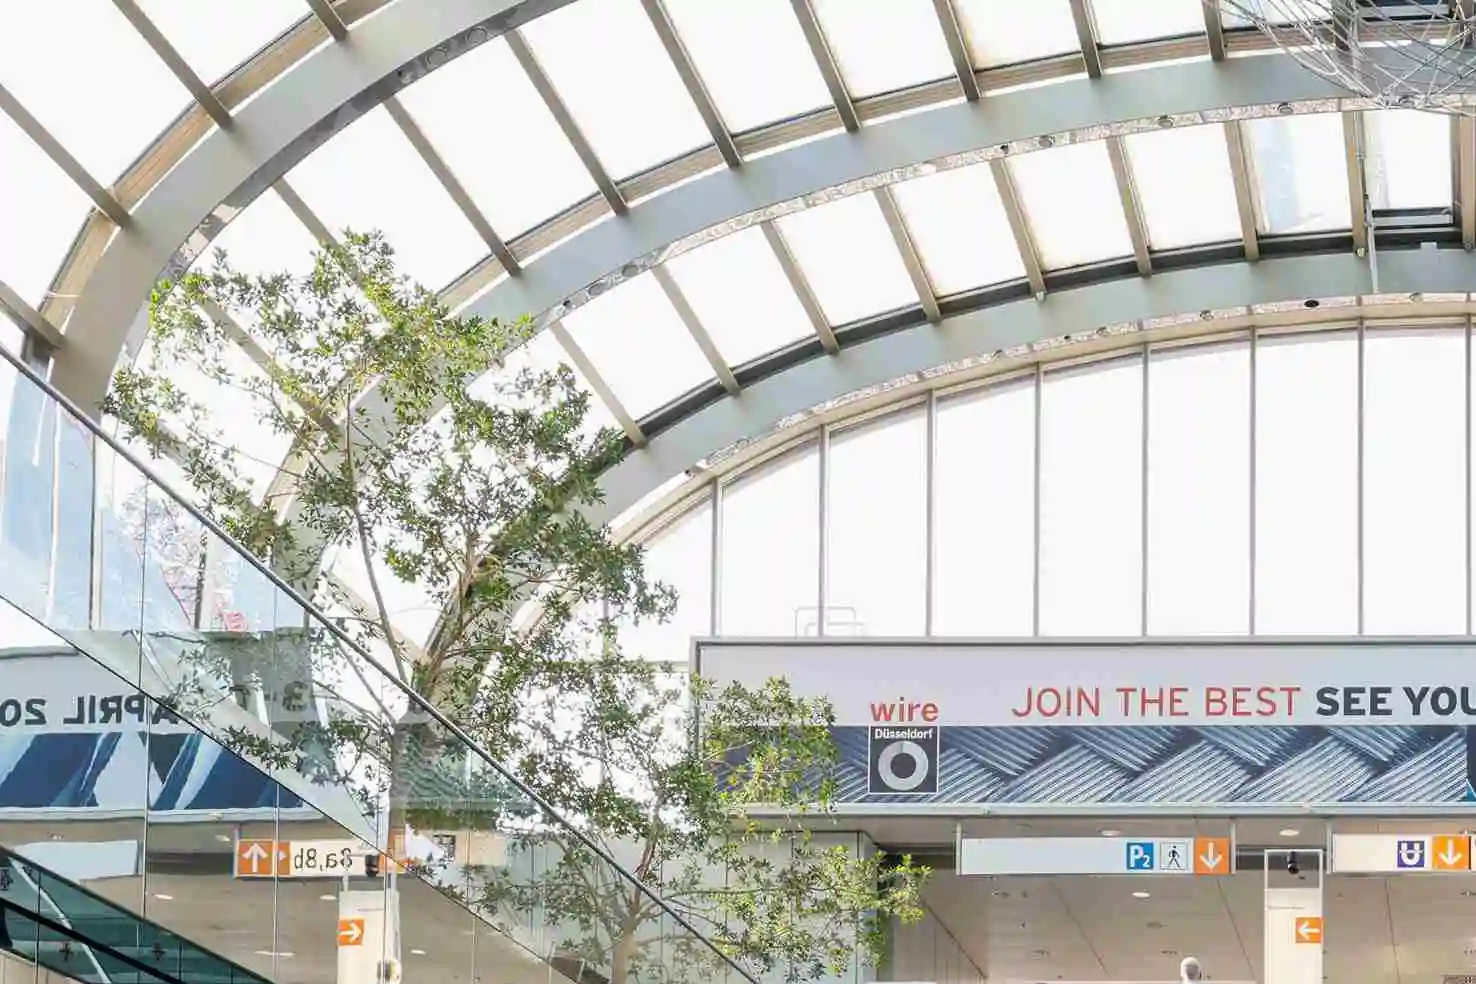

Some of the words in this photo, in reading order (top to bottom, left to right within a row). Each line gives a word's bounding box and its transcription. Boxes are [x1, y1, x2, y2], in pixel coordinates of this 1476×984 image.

[870, 696, 939, 722] wire
[1012, 686, 1100, 717] JOIN
[1115, 687, 1190, 717] THE
[1205, 687, 1301, 717] BEST
[1316, 686, 1393, 716] SEE
[874, 727, 933, 740] Düsseldorf
